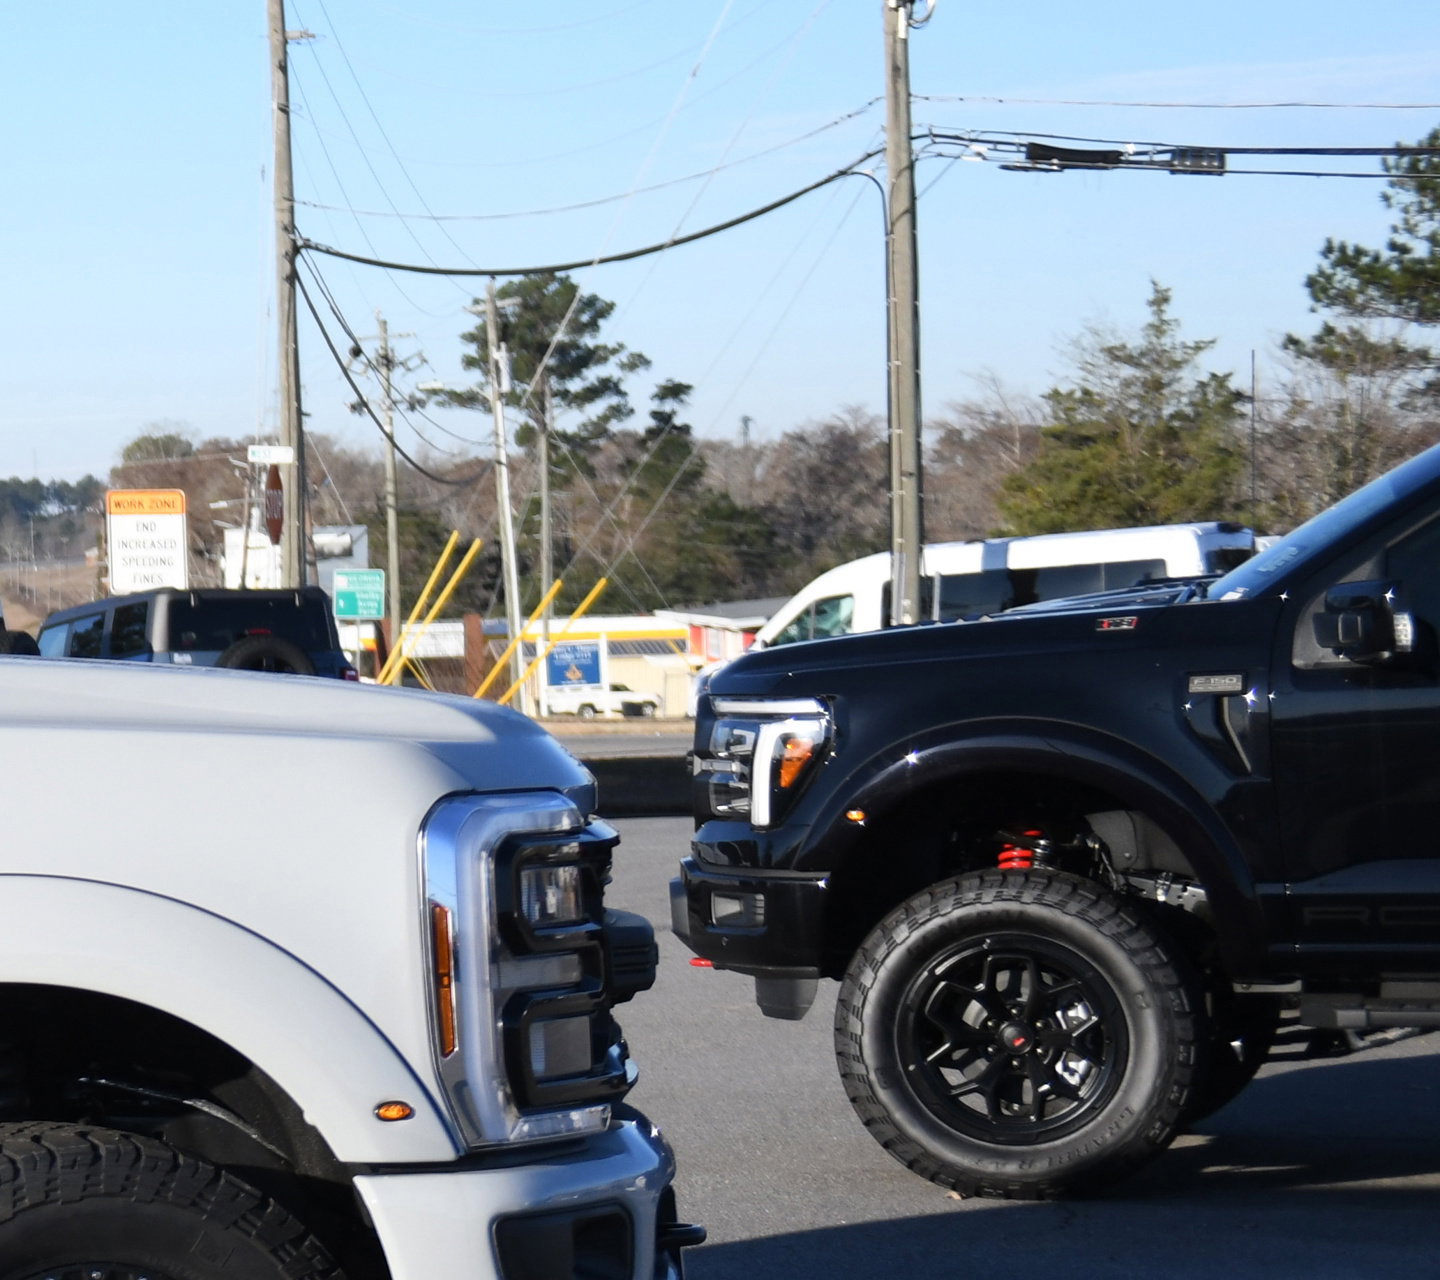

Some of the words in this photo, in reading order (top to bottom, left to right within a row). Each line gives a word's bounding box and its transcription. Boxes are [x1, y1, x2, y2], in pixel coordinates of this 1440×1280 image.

[113, 499, 145, 509] WORK
[149, 499, 177, 509] ZONE
[136, 521, 157, 532] END
[117, 539, 177, 550] INCREASED
[122, 557, 174, 568] SPEEDING
[133, 574, 164, 585] FINES
